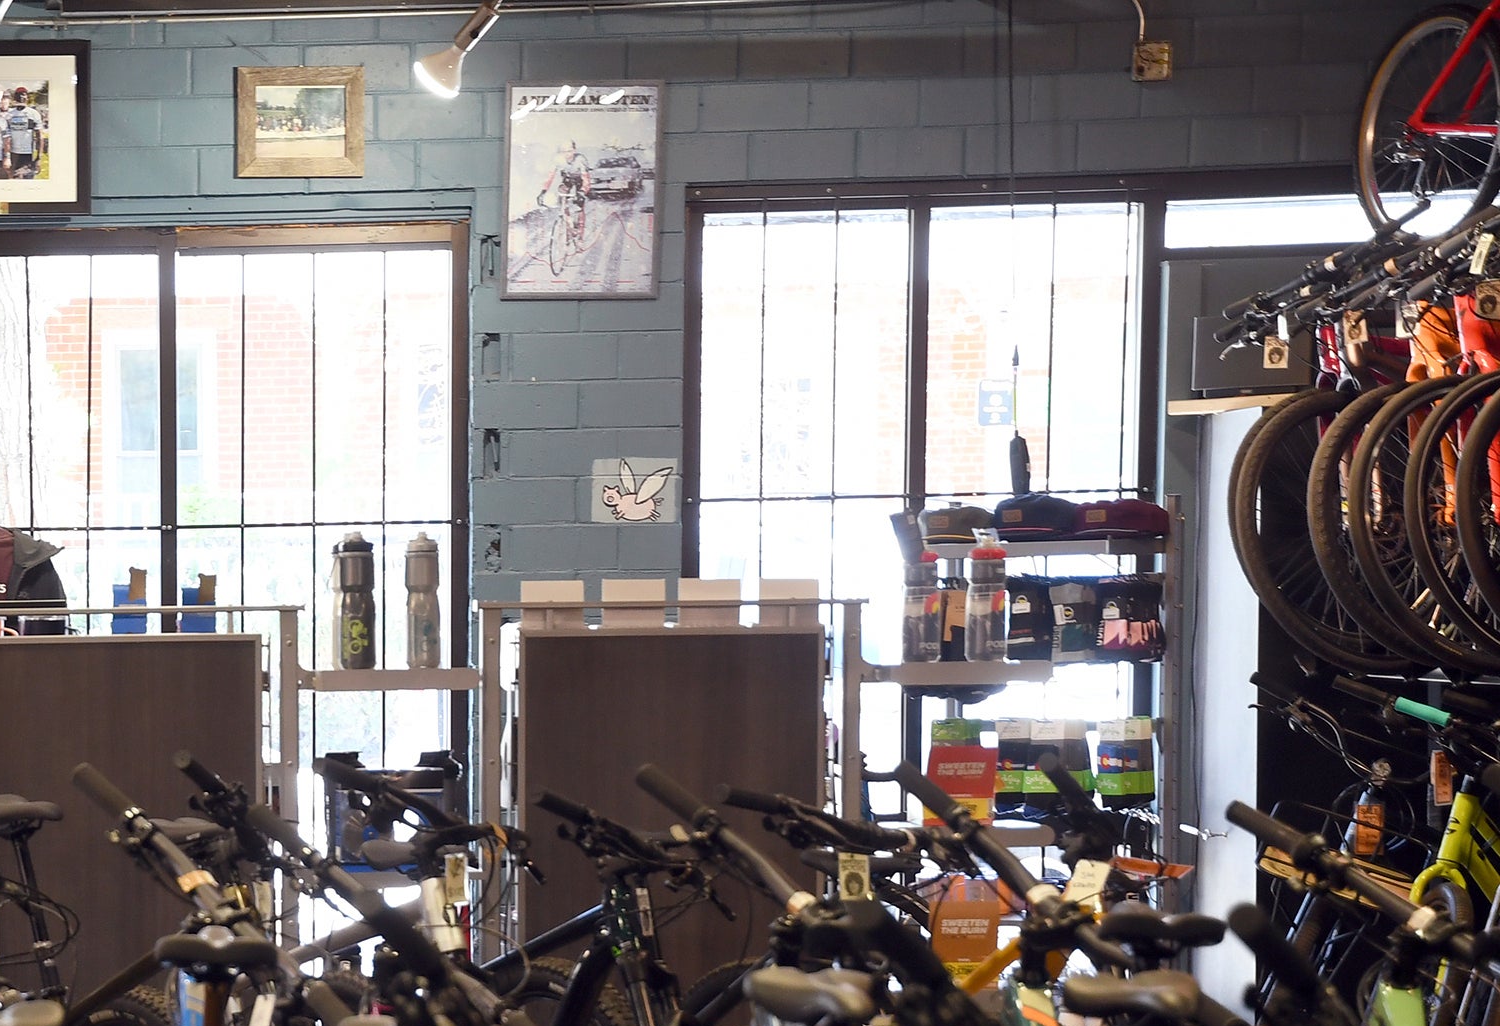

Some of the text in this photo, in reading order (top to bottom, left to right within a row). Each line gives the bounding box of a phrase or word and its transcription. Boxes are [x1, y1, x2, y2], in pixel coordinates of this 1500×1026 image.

[938, 761, 987, 769] SWEETEN
[941, 919, 990, 927] SWEETEN
[941, 926, 988, 934] THE BURN
